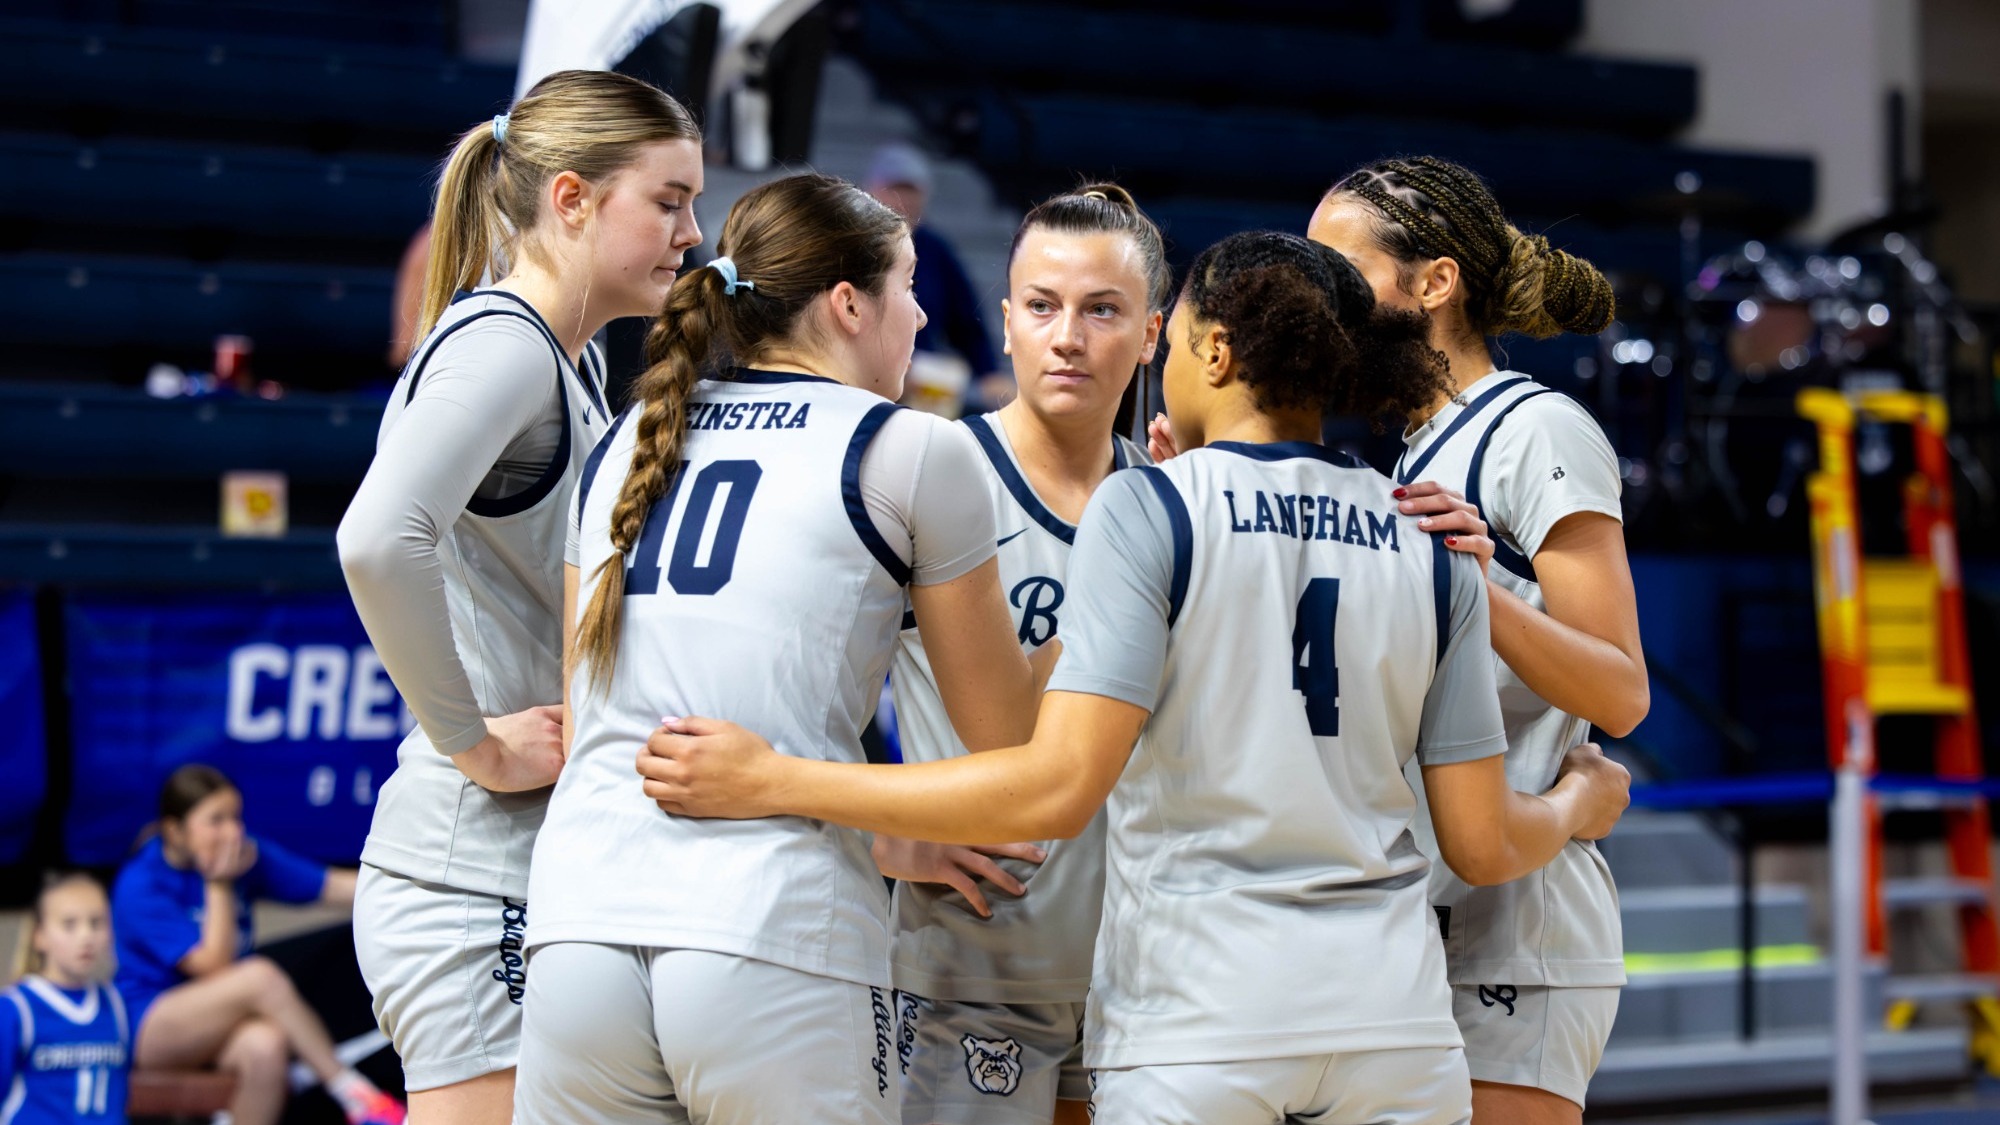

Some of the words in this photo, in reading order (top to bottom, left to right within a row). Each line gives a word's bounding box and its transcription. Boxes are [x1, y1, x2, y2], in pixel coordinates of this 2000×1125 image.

[684, 402, 811, 430] EINSTRA
[624, 459, 763, 595] 10
[1223, 489, 1400, 553] LANGHAM
[1009, 575, 1064, 647] B
[1291, 577, 1340, 737] 4
[225, 642, 419, 743] CRE
[869, 984, 892, 1098] ulldogs
